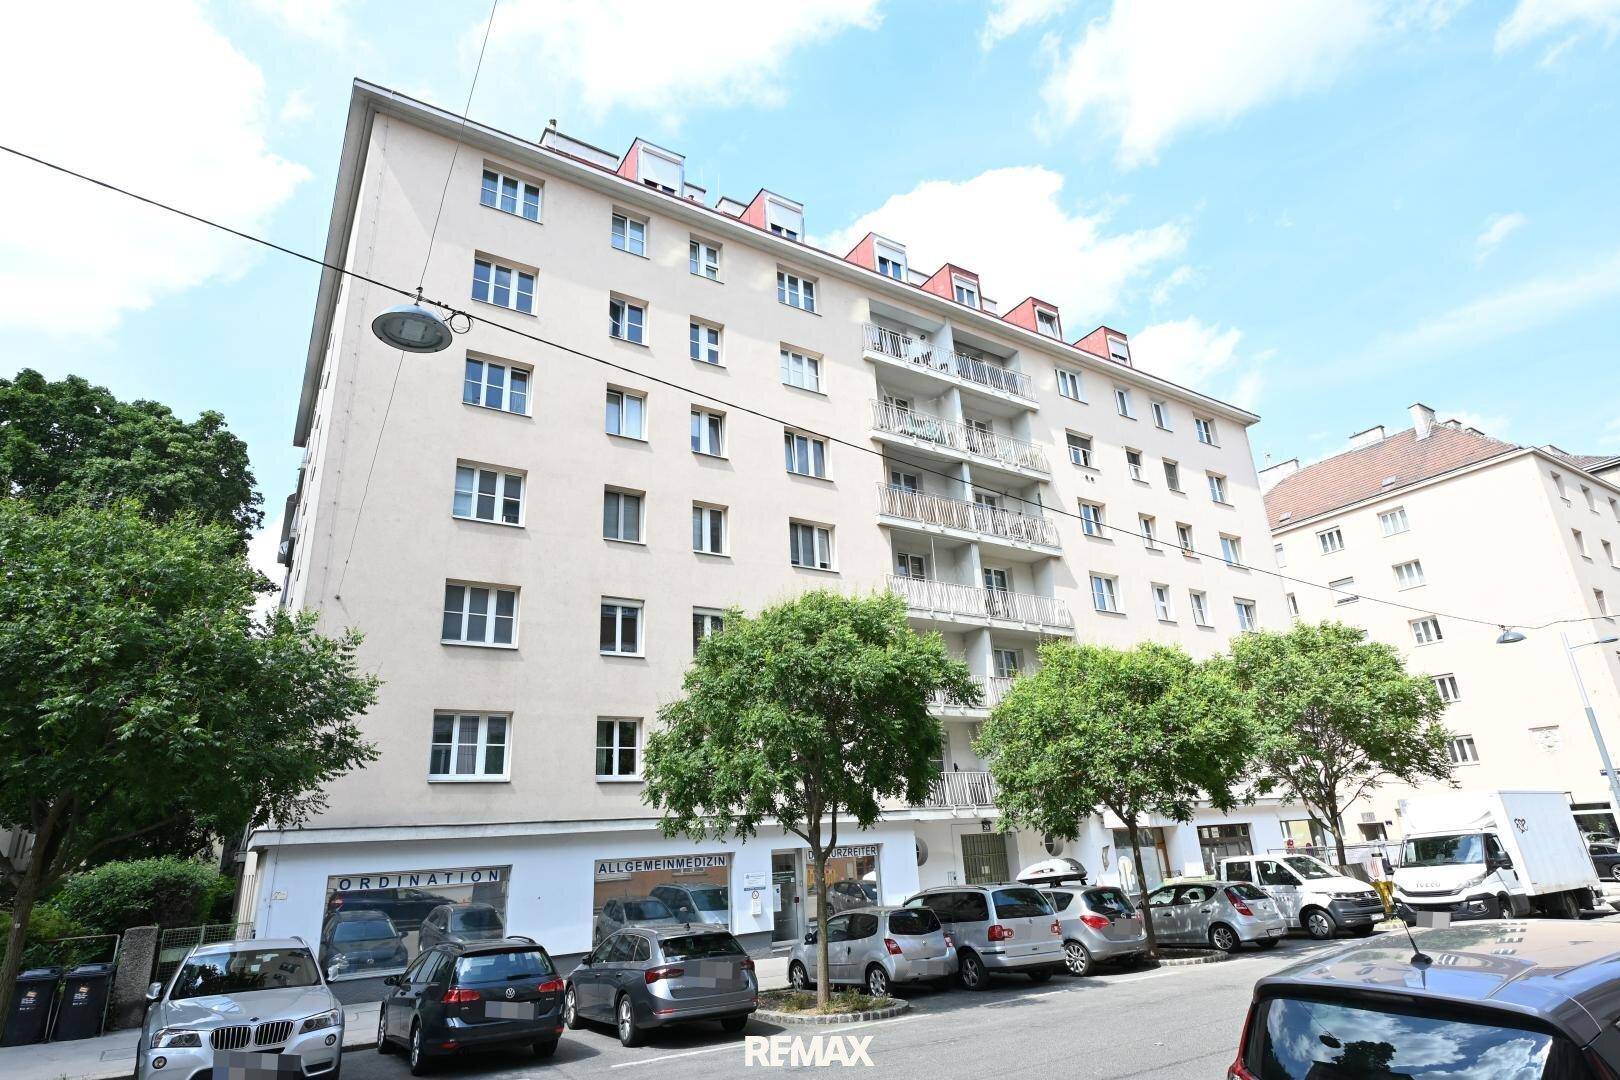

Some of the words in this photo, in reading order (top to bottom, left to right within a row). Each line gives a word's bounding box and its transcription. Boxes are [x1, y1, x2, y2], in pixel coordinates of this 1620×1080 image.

[831, 846, 877, 858] URZREITER
[598, 856, 726, 874] ALLGEMEINMEDIZIN
[339, 869, 499, 891] ORDINATION
